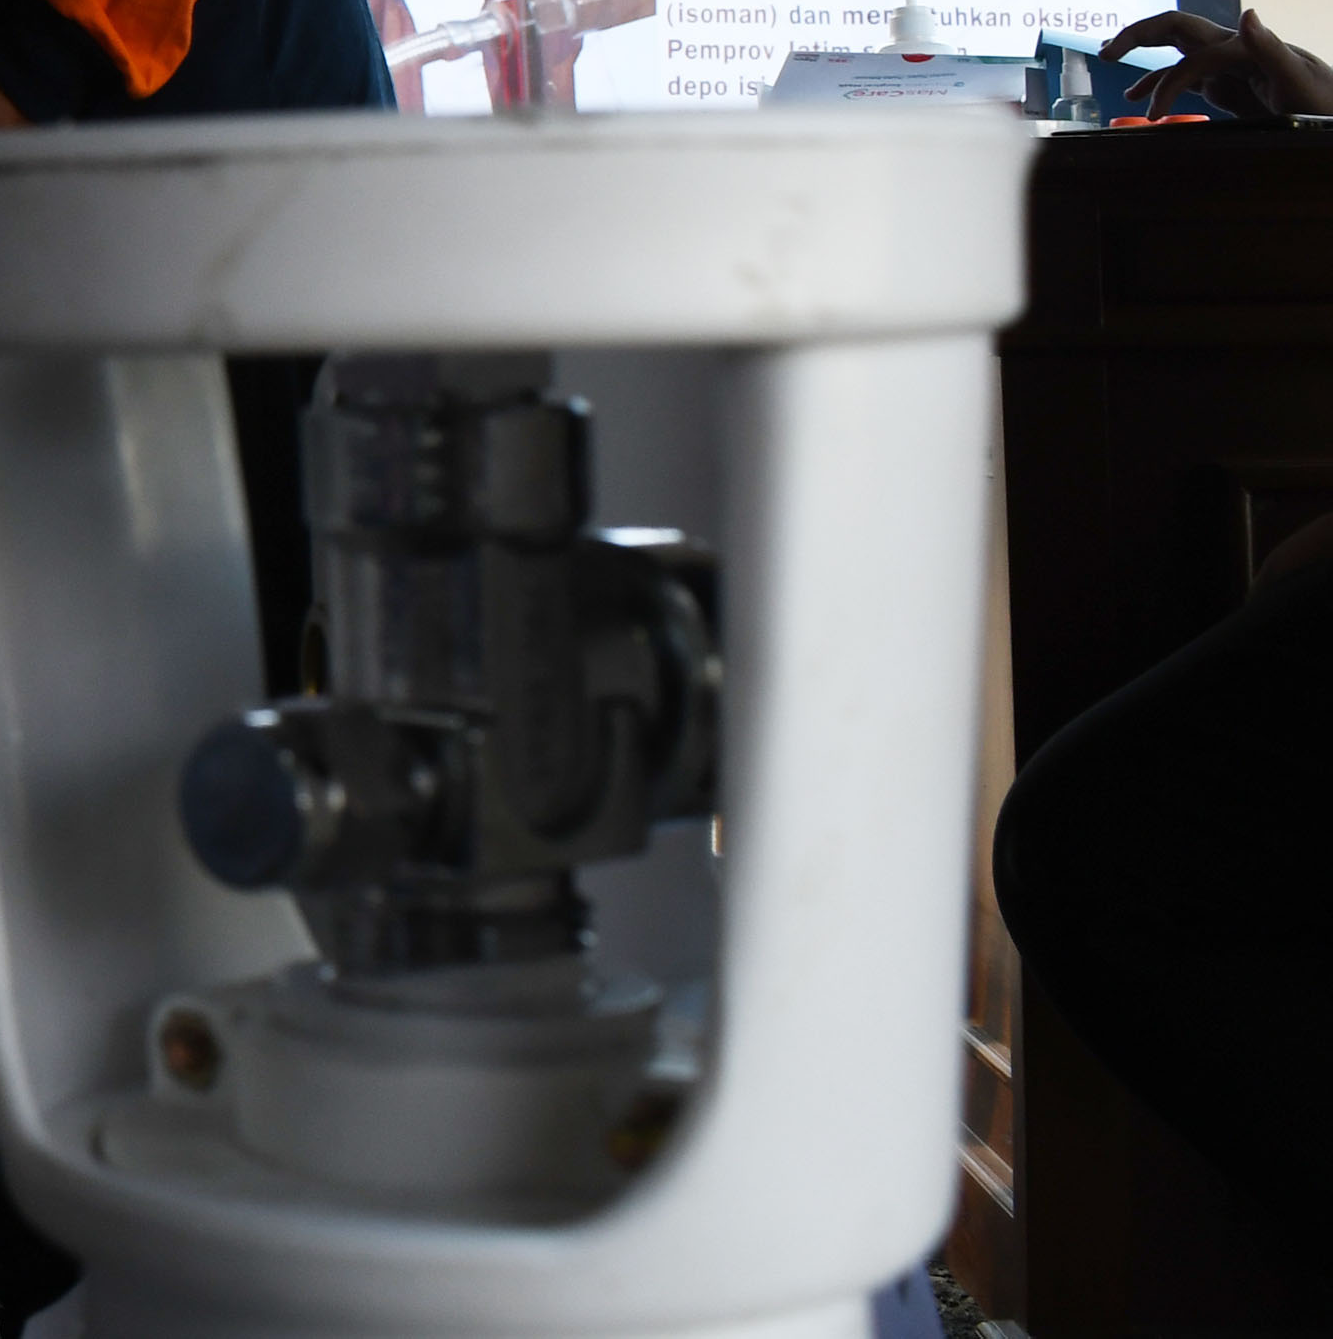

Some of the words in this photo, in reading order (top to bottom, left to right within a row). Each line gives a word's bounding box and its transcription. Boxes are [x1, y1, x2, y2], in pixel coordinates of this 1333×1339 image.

[666, 3, 777, 28] (isoman)
[789, 5, 831, 25] dan
[667, 39, 775, 64] Pemprov
[668, 76, 728, 99] depo
